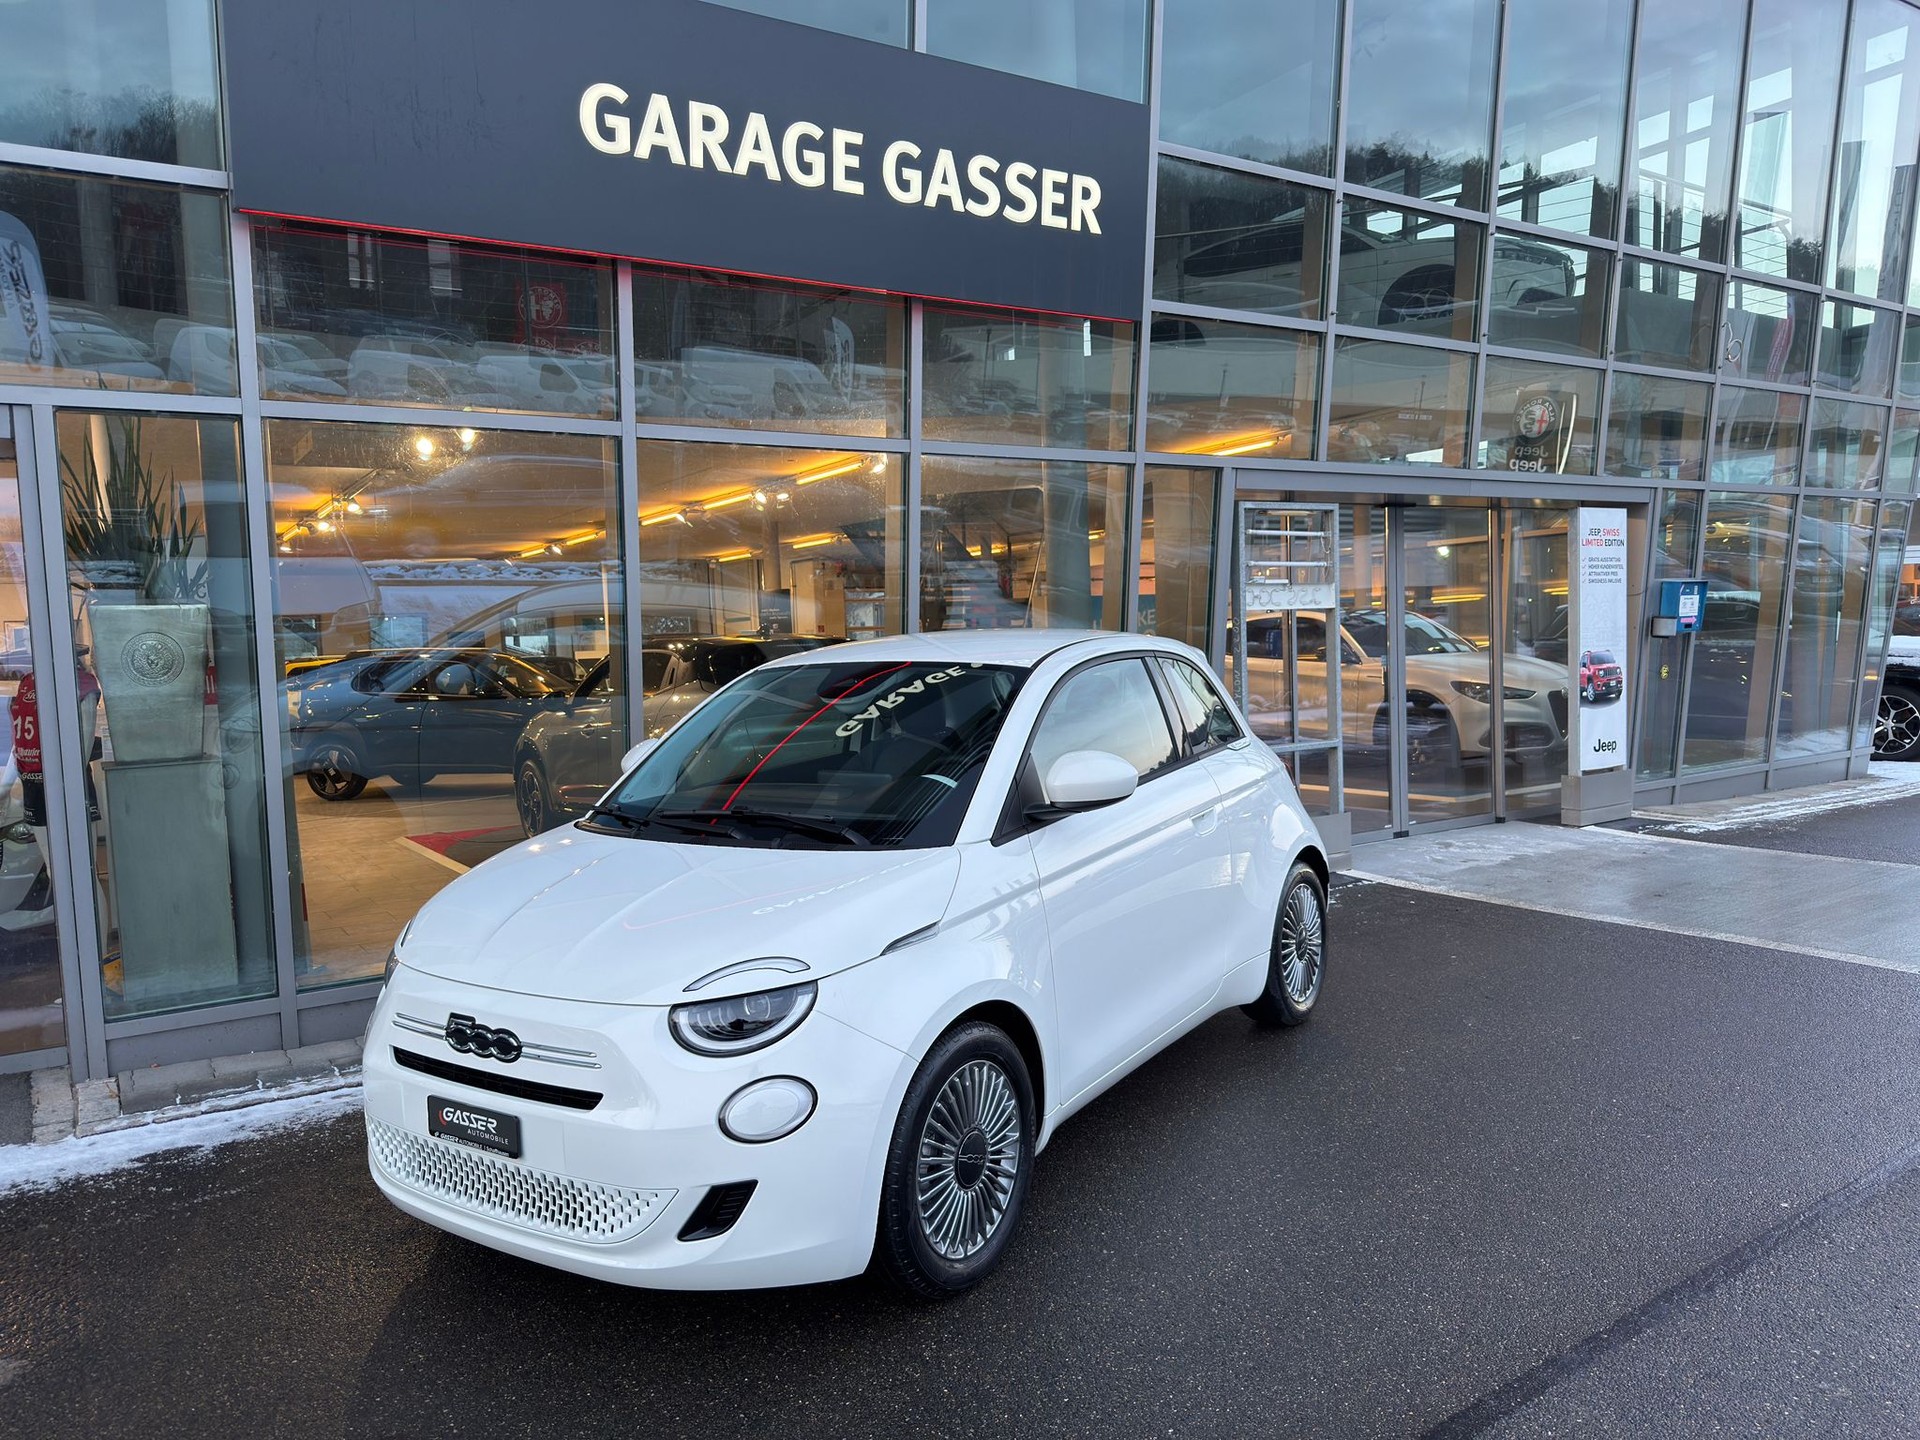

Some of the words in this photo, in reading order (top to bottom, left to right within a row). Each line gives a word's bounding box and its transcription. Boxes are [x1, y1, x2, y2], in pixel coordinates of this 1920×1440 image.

[579, 82, 864, 196] GARAGE
[882, 140, 1102, 234] GASSER
[1602, 528, 1620, 536] SWISS
[13, 715, 34, 740] 15
[1594, 738, 1617, 753] Jeep
[22, 772, 43, 780] GASSE
[445, 1012, 522, 1063] 500
[442, 1107, 497, 1134] GASSER
[468, 1128, 509, 1145] AUTOMOBILE
